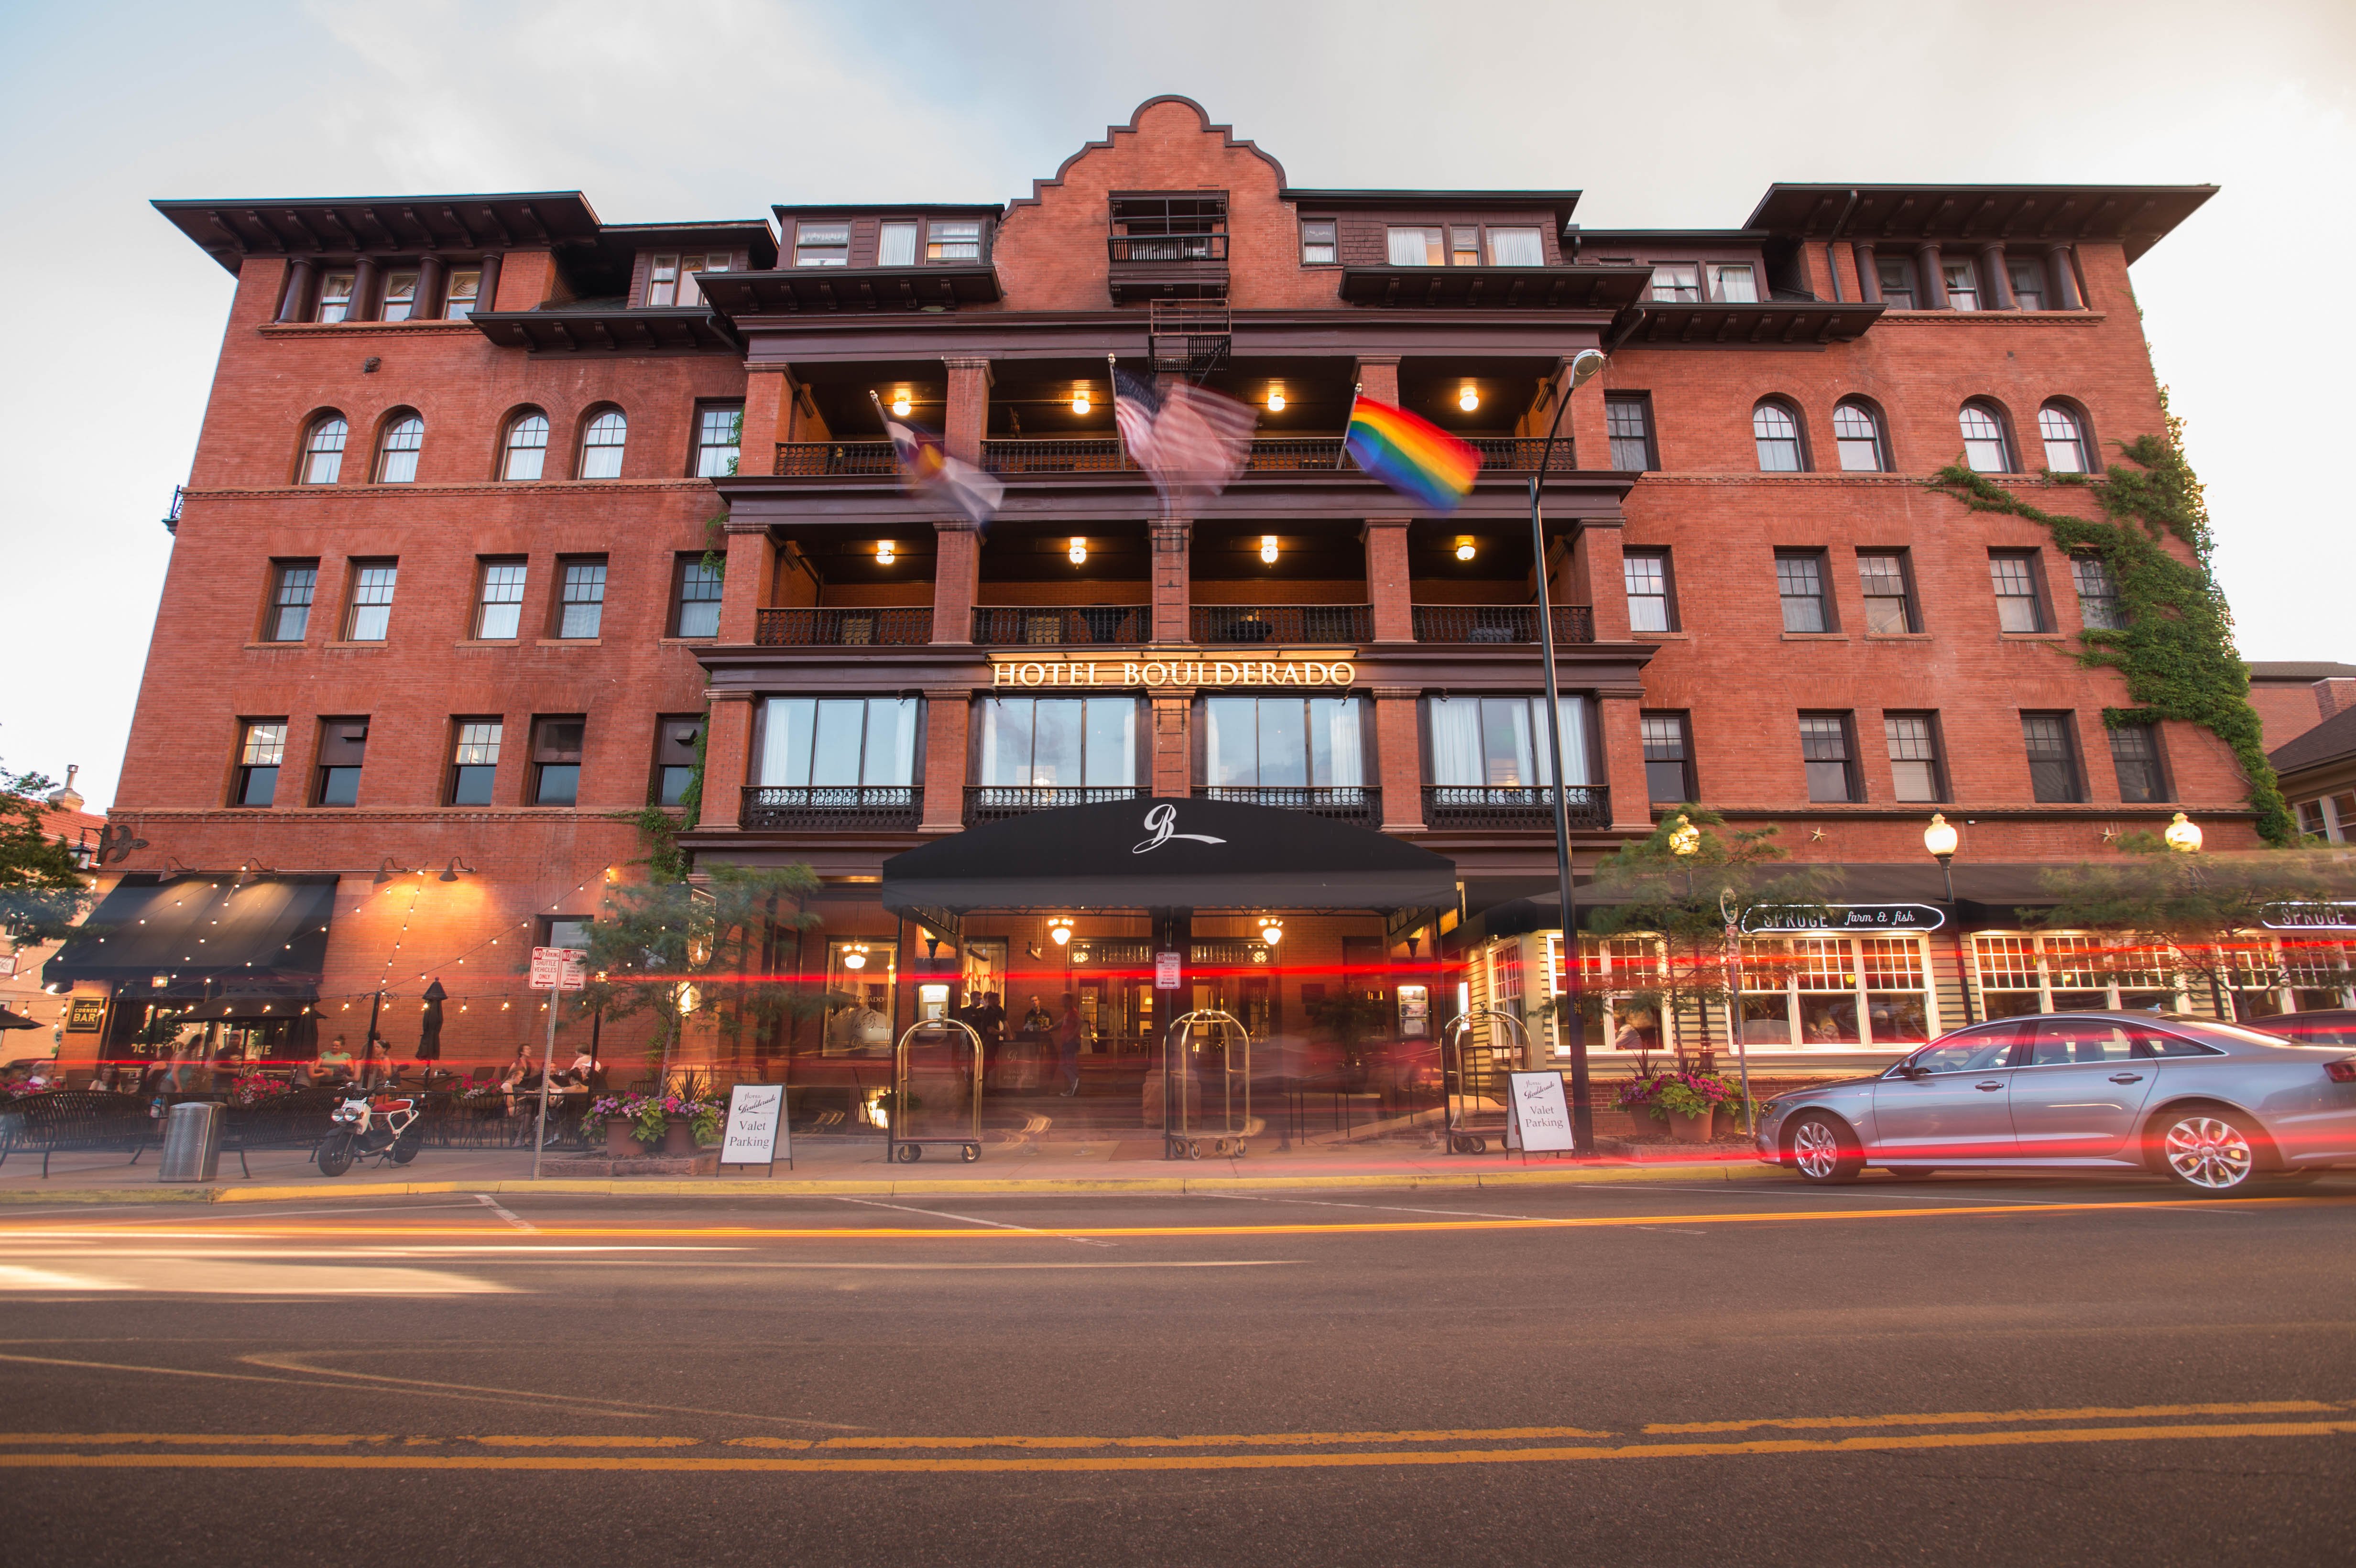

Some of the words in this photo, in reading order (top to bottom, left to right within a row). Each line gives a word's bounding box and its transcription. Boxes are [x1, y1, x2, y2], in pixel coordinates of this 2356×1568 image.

[993, 663, 1103, 686] HOTEL
[1122, 662, 1356, 686] BOULDERADO
[1133, 804, 1227, 853] B
[1844, 911, 1873, 926] farm
[1877, 912, 1887, 923] &
[1891, 910, 1915, 926] fish
[2281, 907, 2347, 925] SPRUCE
[534, 950, 542, 958] NO
[562, 951, 570, 960] NO
[73, 1013, 96, 1022] BAR
[1530, 1106, 1554, 1114] Valet
[740, 1121, 766, 1131] Valet
[1525, 1118, 1563, 1129] Parking
[729, 1136, 770, 1149] Parking
